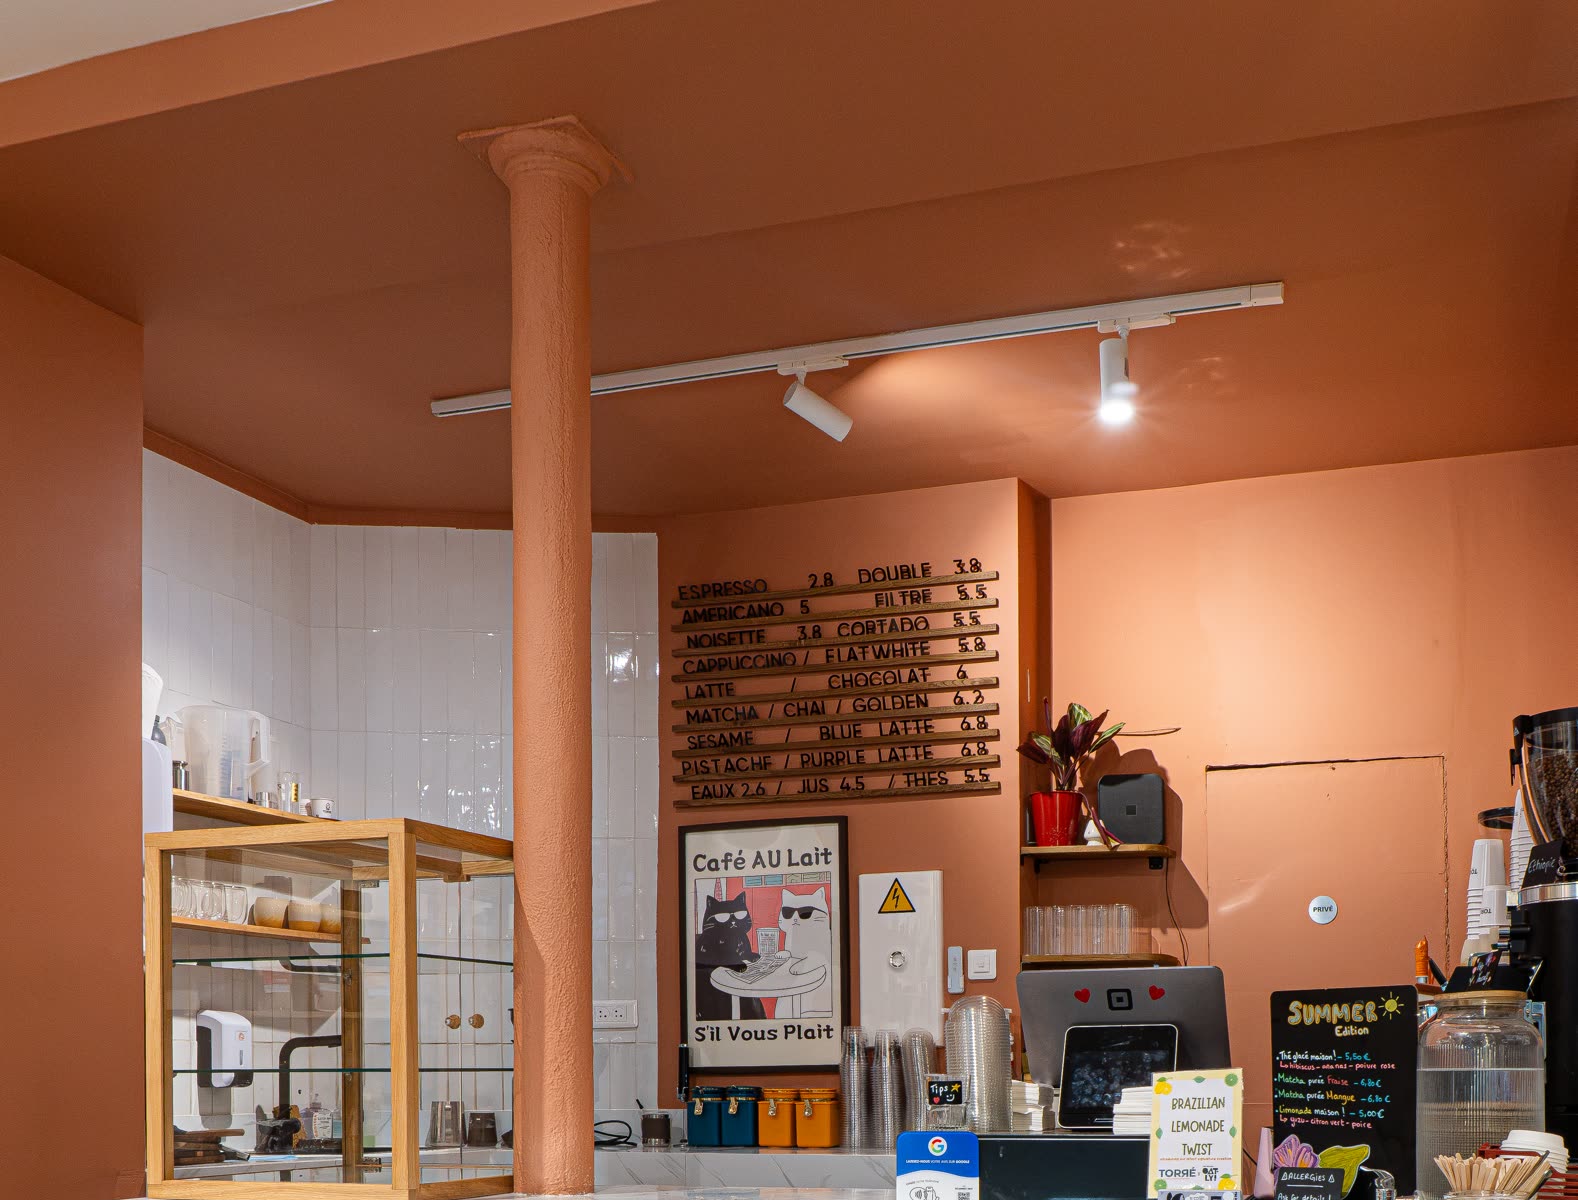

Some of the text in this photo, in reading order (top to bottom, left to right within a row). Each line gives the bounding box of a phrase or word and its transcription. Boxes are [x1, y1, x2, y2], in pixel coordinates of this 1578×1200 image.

[677, 557, 982, 600] ESPRESSO 2.8 DOUBLE 3.8
[682, 584, 986, 624] AMERICANO 5 FILTRE 5.5
[686, 610, 981, 649] NOISETTE 3.8 CORTADO 5.5
[682, 651, 797, 675] CAPPUCCINO
[958, 636, 986, 653] 5.8
[685, 682, 736, 700] LATTE
[827, 667, 930, 690] CHOCOLAT
[956, 664, 967, 680] 6
[685, 705, 759, 725] MATCHA
[783, 700, 826, 718] CHAI
[852, 693, 929, 713] GOLDEN
[953, 689, 984, 706] 6.2
[687, 731, 755, 750] SESAME
[819, 723, 863, 741] BLUE
[878, 718, 934, 737] LATTE
[960, 715, 988, 731] 6.8
[800, 750, 866, 769] PURPLE
[877, 744, 934, 763] LATTE
[961, 741, 989, 757] 6.8
[691, 783, 736, 800] EAUX
[741, 782, 766, 797] 2.6
[797, 778, 829, 794] JUS
[840, 775, 865, 791] 4.5
[902, 770, 949, 787] THES
[964, 767, 990, 783] 5.5
[692, 847, 833, 873] Café AU Lait
[1312, 904, 1334, 913] PRIVÉ
[1287, 1000, 1379, 1025] SUMMER
[694, 1024, 834, 1042] S'il Vous Plait
[1334, 1025, 1370, 1037] Edition
[1279, 1050, 1291, 1060] Thé
[1292, 1050, 1309, 1063] glacé
[1289, 1063, 1316, 1071] hibiscus
[1355, 1062, 1377, 1071] poivre
[1277, 1072, 1306, 1085] Matcha
[1307, 1075, 1325, 1087] purée
[1326, 1075, 1349, 1086] Fraise
[930, 1083, 949, 1097] Tips
[1277, 1089, 1306, 1099] Matcha
[1306, 1090, 1325, 1101] purée
[1325, 1090, 1356, 1105] Mangue
[1171, 1096, 1226, 1110] BRAZILIAN
[1279, 1104, 1312, 1115] Limonade
[1171, 1119, 1225, 1133] LEMONADE
[1310, 1117, 1329, 1126] citron
[1330, 1118, 1345, 1127] vert
[1351, 1120, 1373, 1130] poire
[1182, 1143, 1213, 1156] TWIST
[1277, 1192, 1289, 1200] Ask
